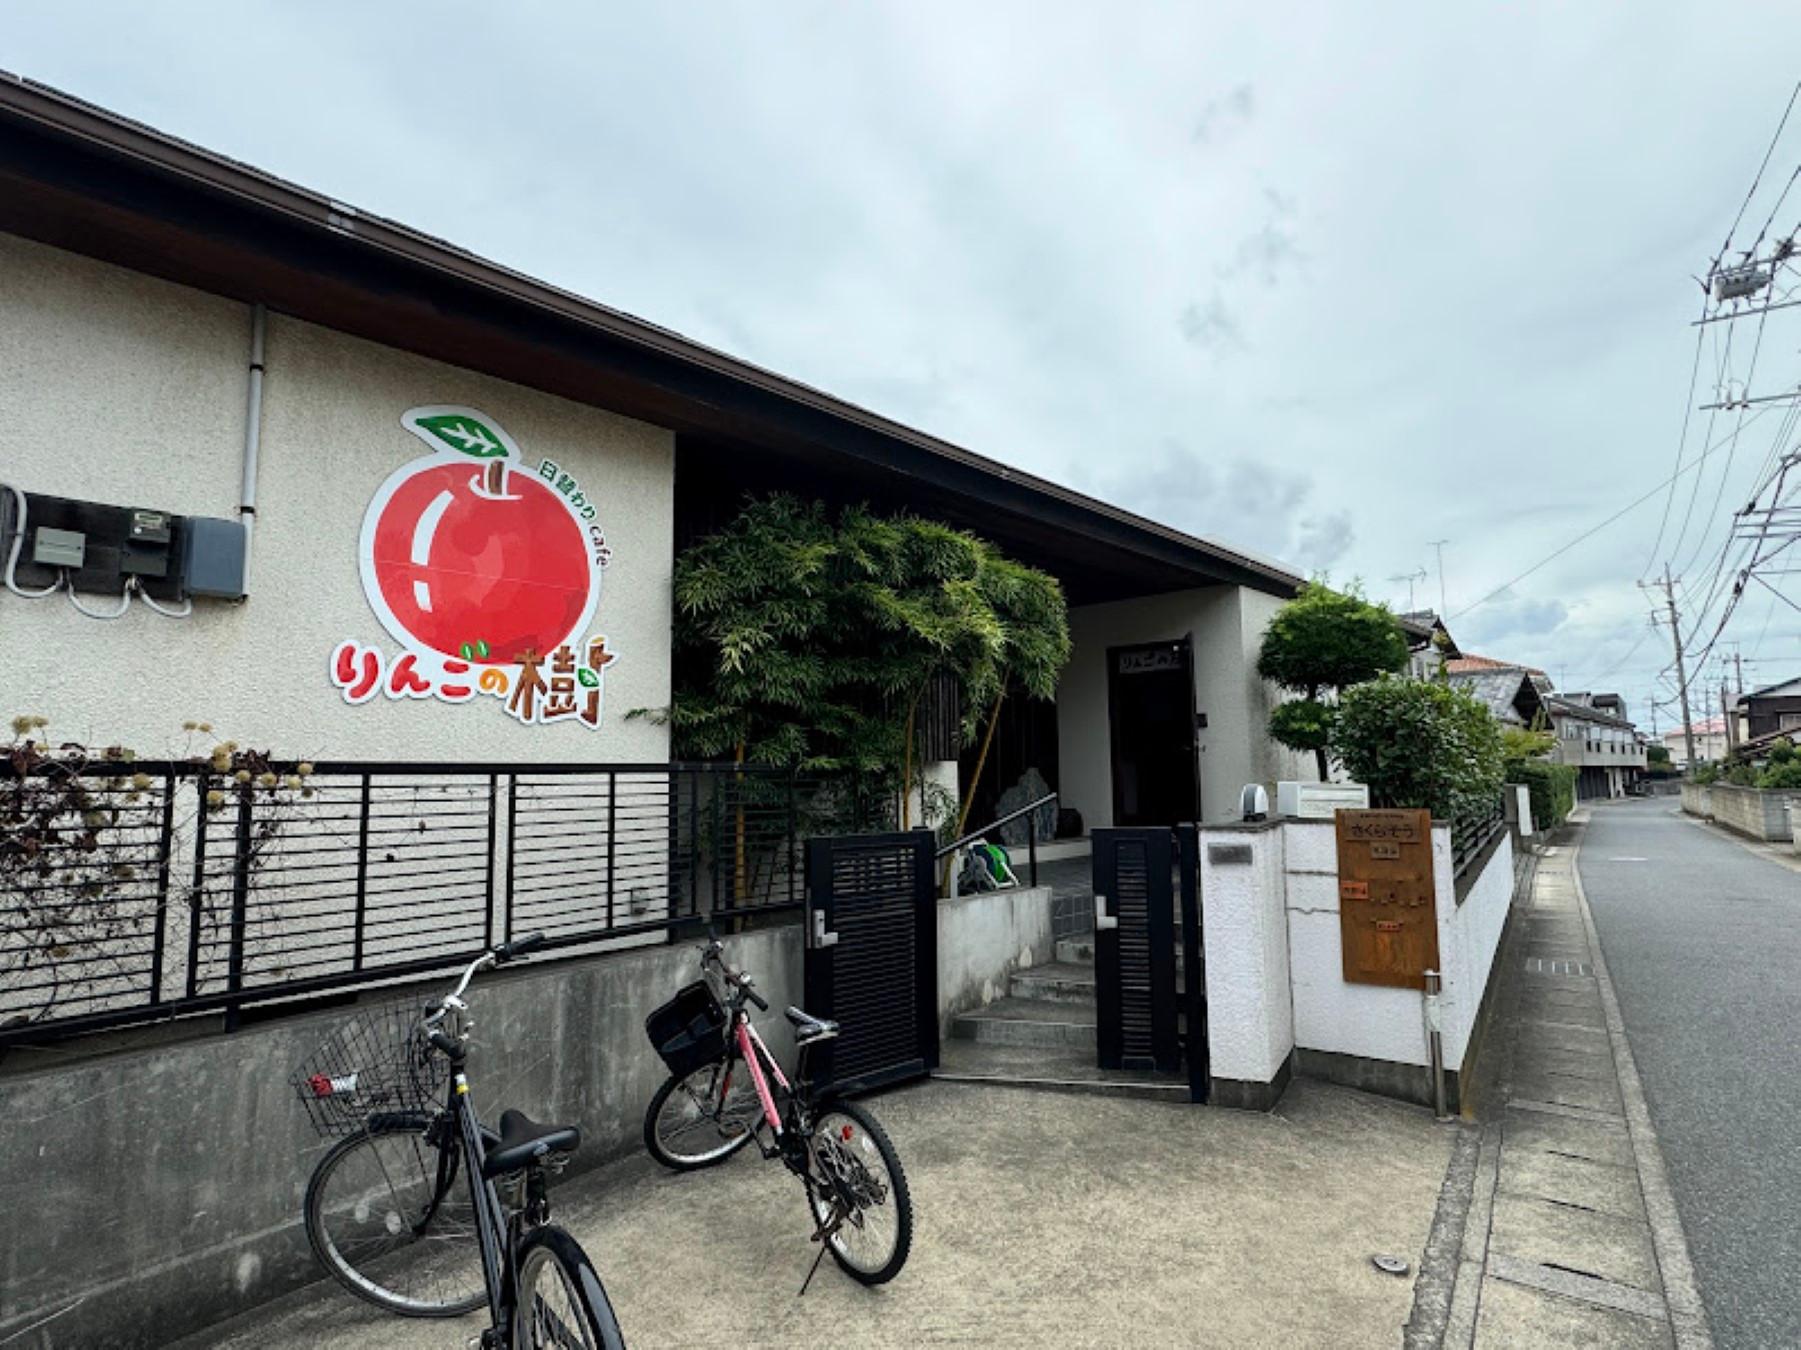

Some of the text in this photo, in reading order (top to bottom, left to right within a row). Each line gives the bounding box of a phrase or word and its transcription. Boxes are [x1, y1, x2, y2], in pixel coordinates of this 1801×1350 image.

[540, 460, 611, 566] 日替わり cafe
[336, 638, 614, 725] りんごの樹
[1351, 823, 1415, 838] さくらそう
